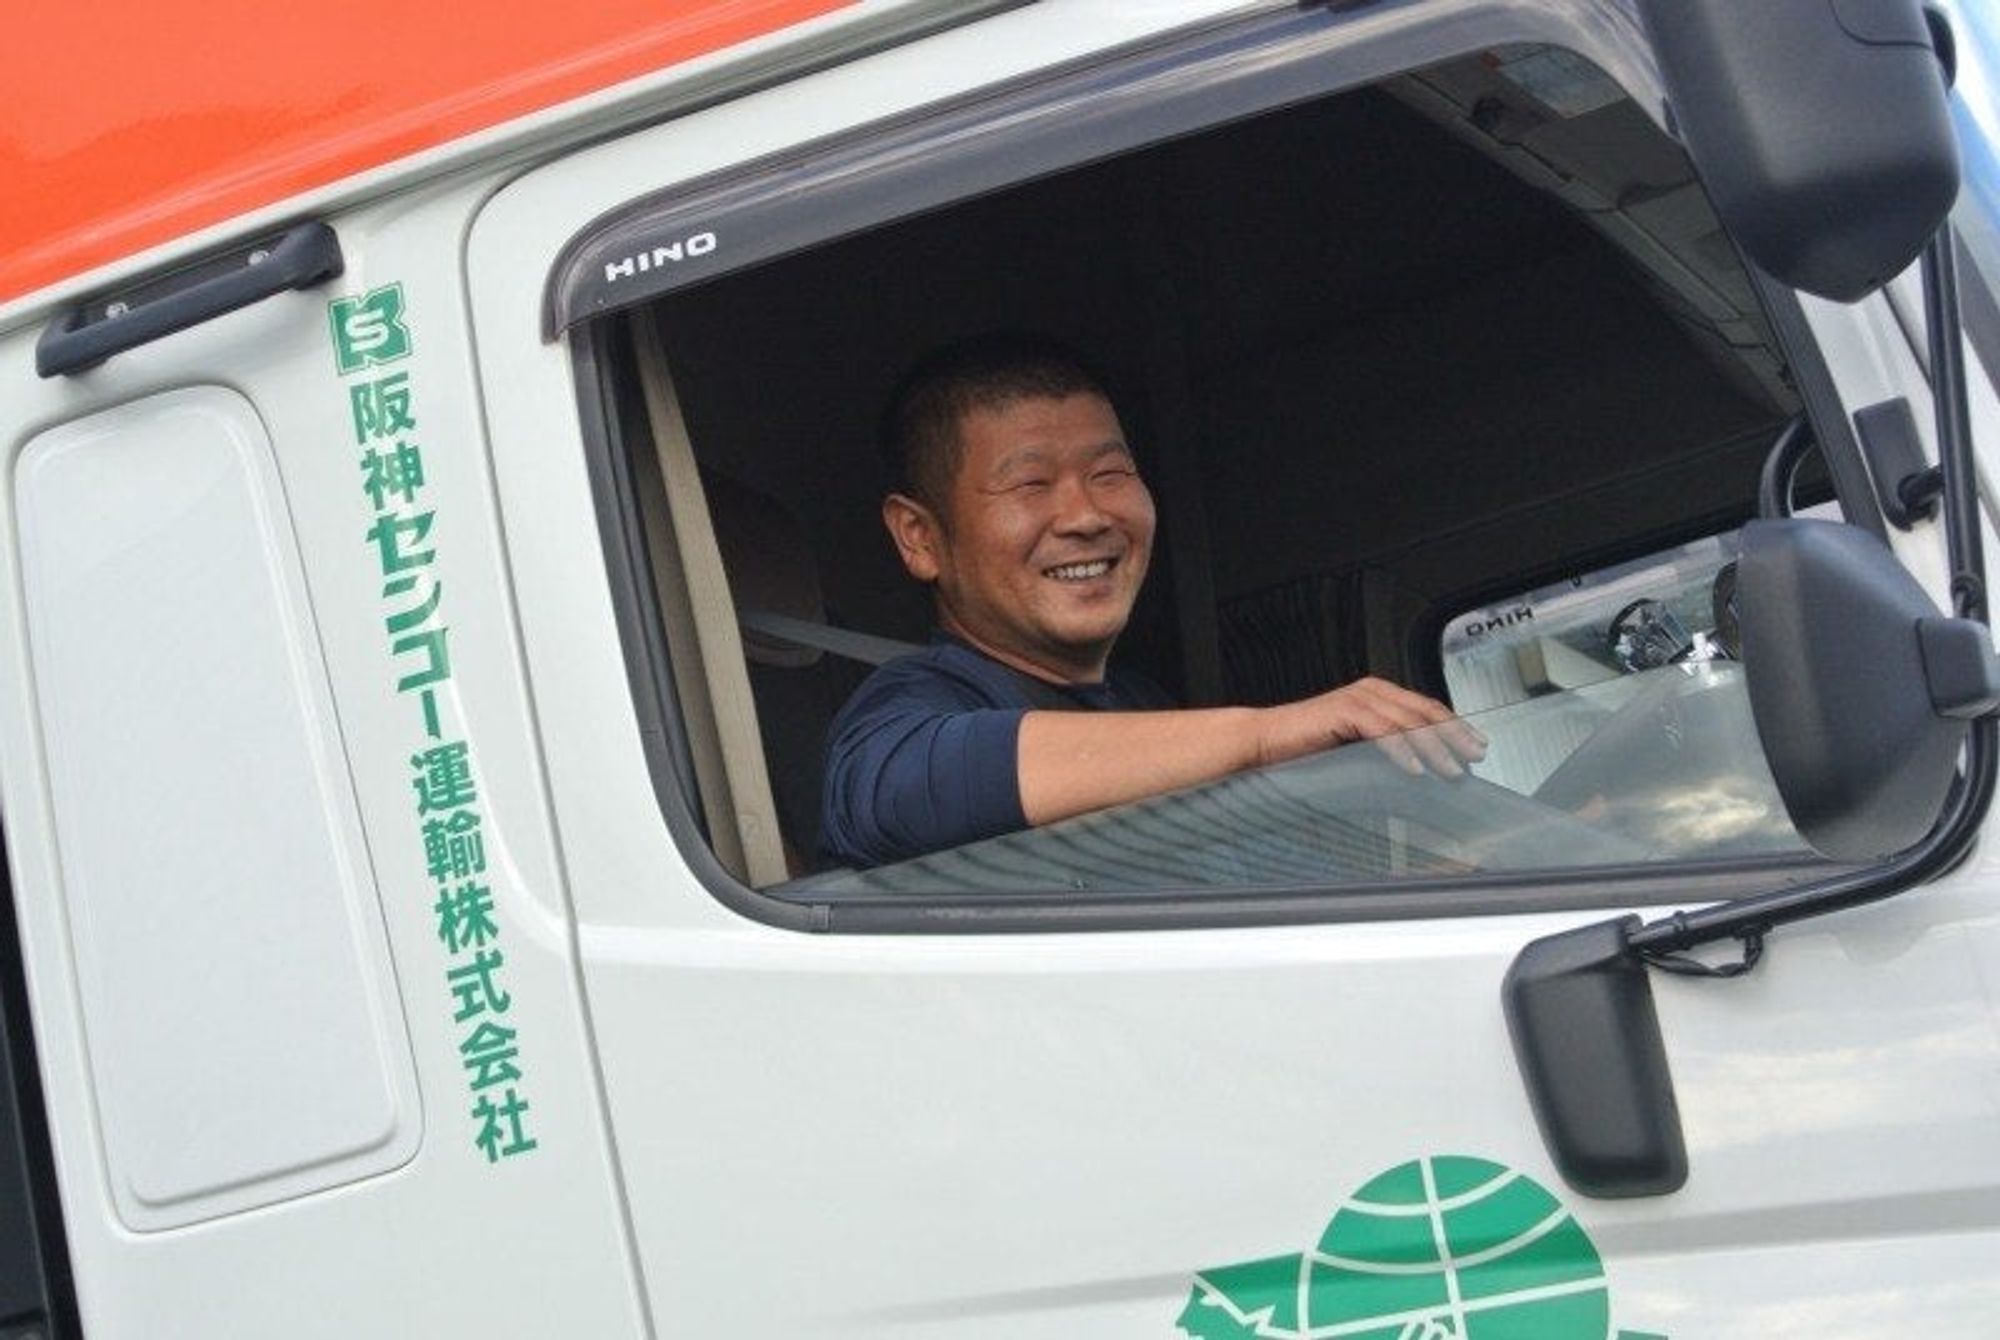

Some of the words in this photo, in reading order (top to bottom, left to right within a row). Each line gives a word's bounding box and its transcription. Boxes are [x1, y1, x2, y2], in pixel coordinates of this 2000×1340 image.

[604, 231, 717, 282] HINO
[348, 370, 538, 1164] 阪神センコー運輸株式会社
